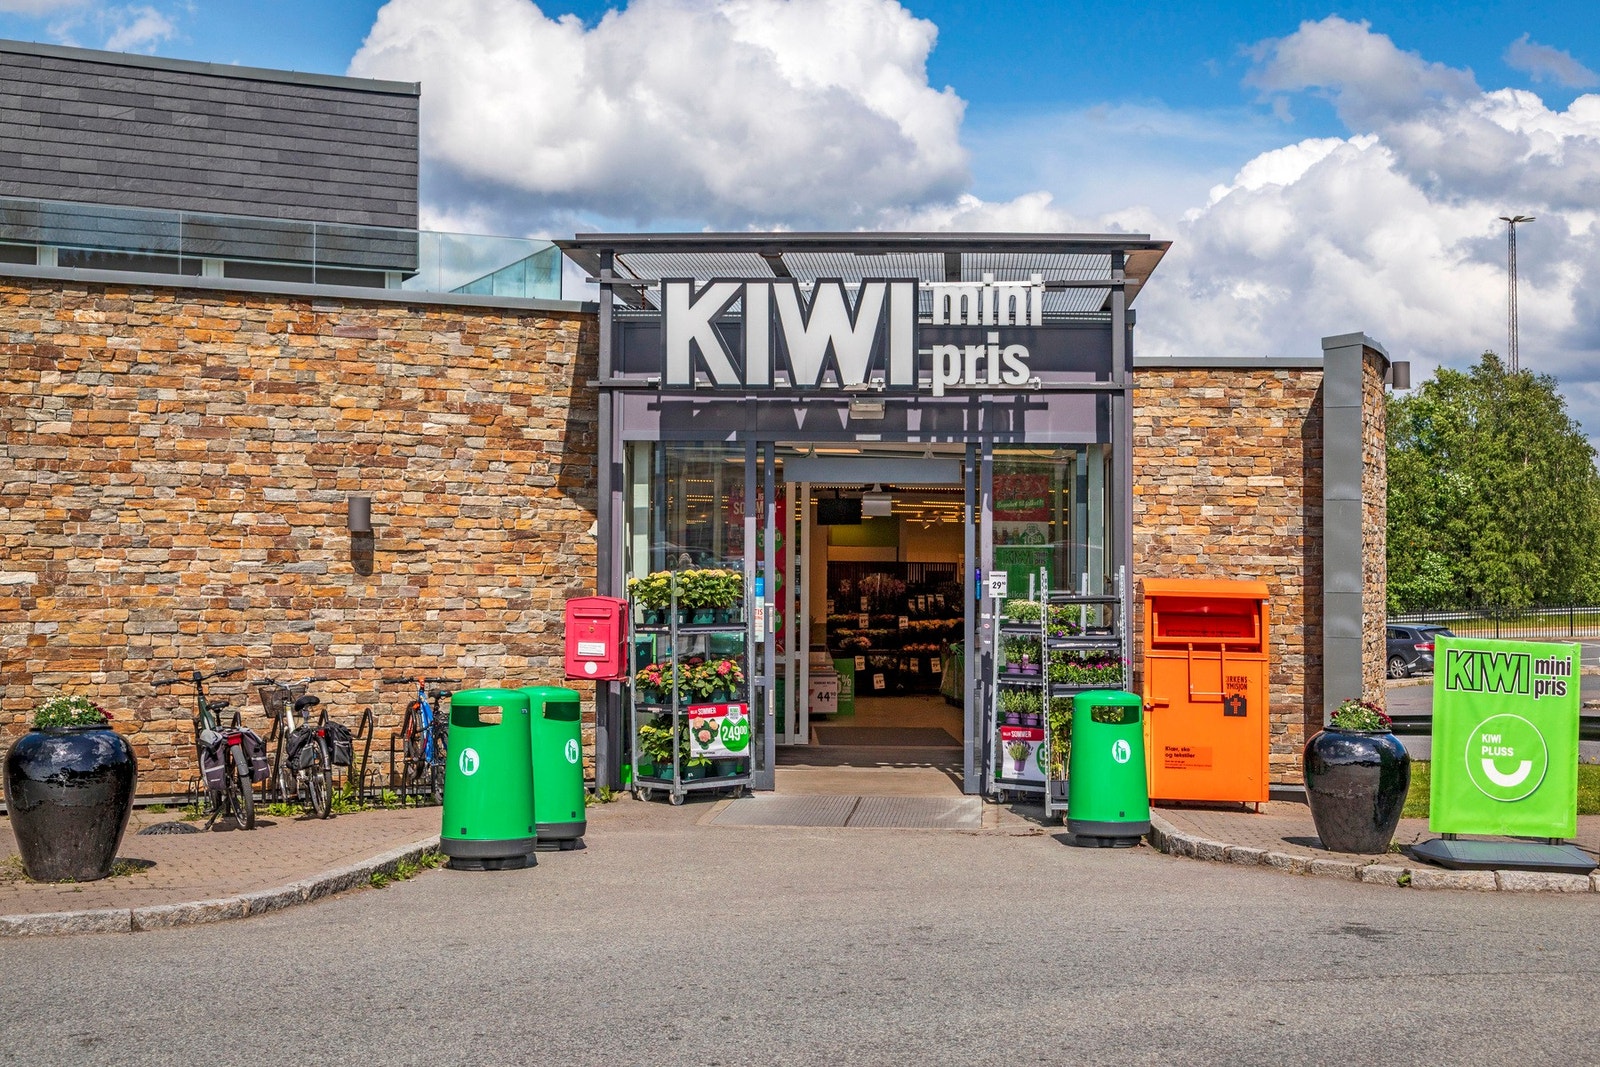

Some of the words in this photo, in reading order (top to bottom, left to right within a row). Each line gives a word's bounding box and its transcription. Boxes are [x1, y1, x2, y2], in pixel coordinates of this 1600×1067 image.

[661, 277, 920, 391] KIWI
[932, 273, 1042, 326] mini
[931, 332, 1031, 396] pris
[1446, 649, 1531, 694] KIWI
[1534, 656, 1571, 676] mini
[1534, 675, 1567, 700] pris
[1481, 733, 1502, 744] KIWI
[1481, 745, 1514, 757] PLUSS
